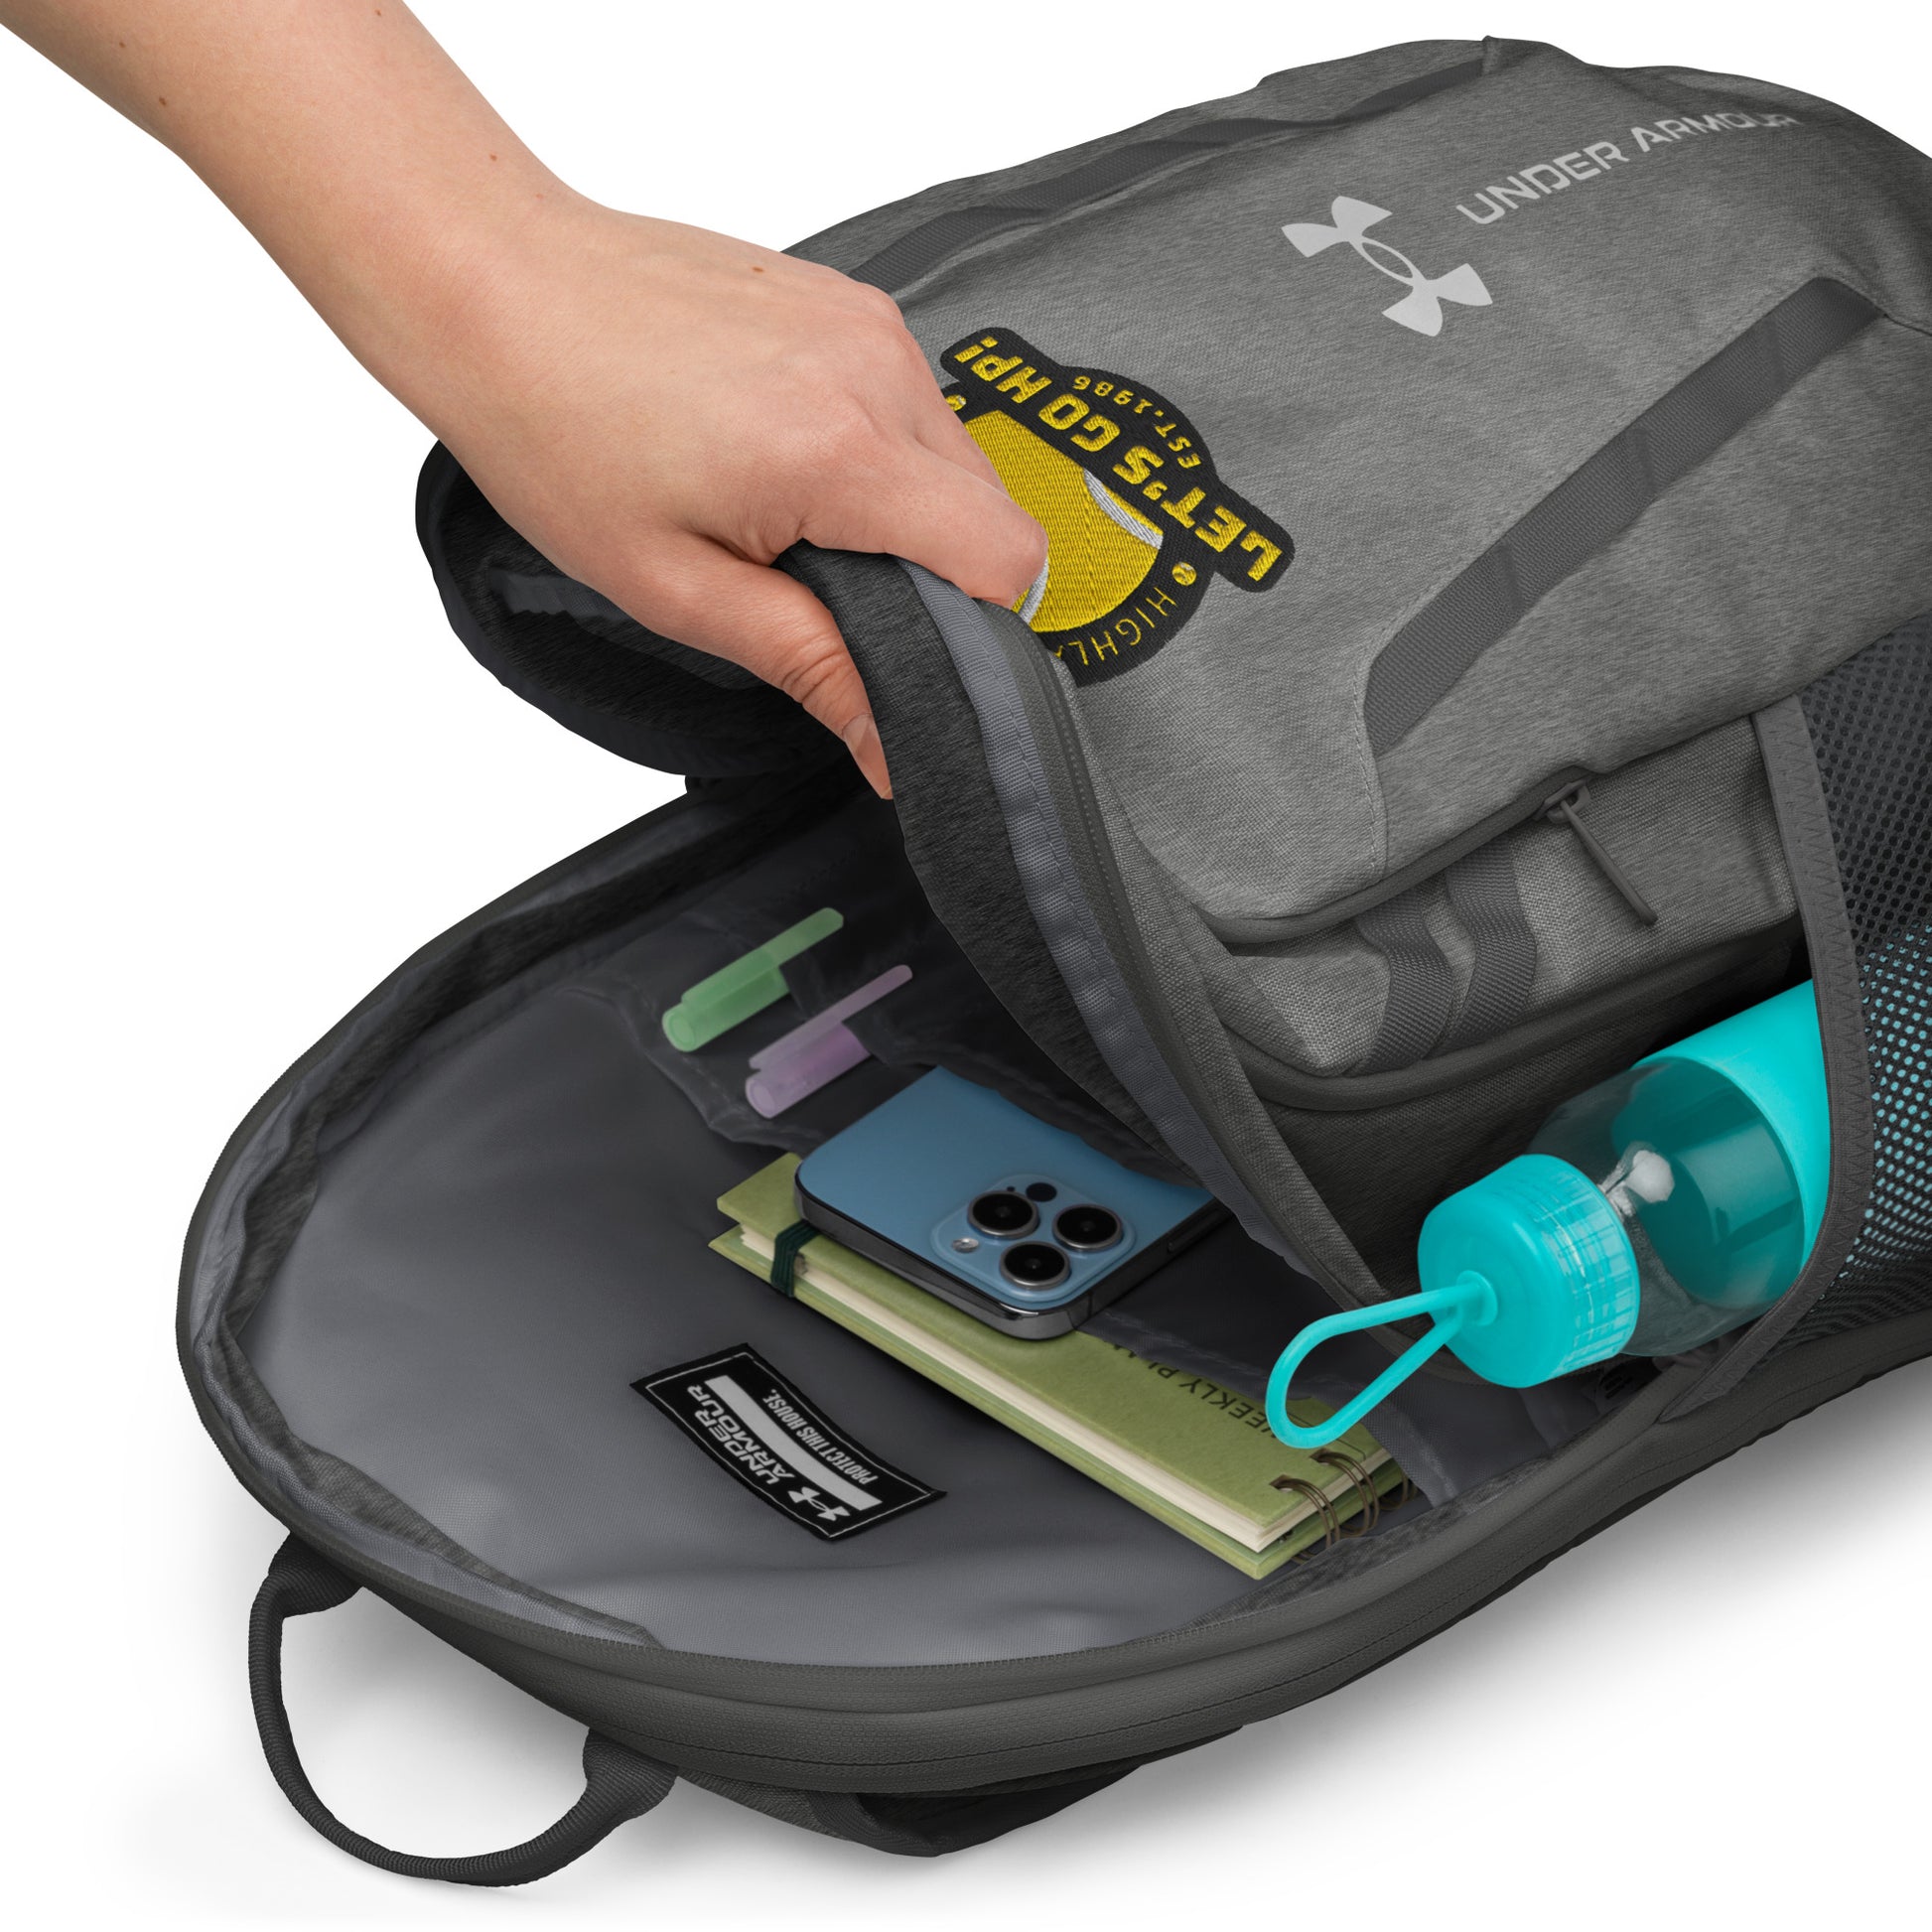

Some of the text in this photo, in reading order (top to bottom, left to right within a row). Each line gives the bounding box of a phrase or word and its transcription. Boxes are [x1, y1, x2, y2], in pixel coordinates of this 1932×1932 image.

[1455, 112, 1802, 224] UNDER ARMOUR
[954, 337, 1283, 582] LET'S GO HP!
[687, 1385, 795, 1478] ARMOUR
[695, 1410, 779, 1484] UNDER
[762, 1389, 879, 1485] PROTECT THIS HOUSE.
